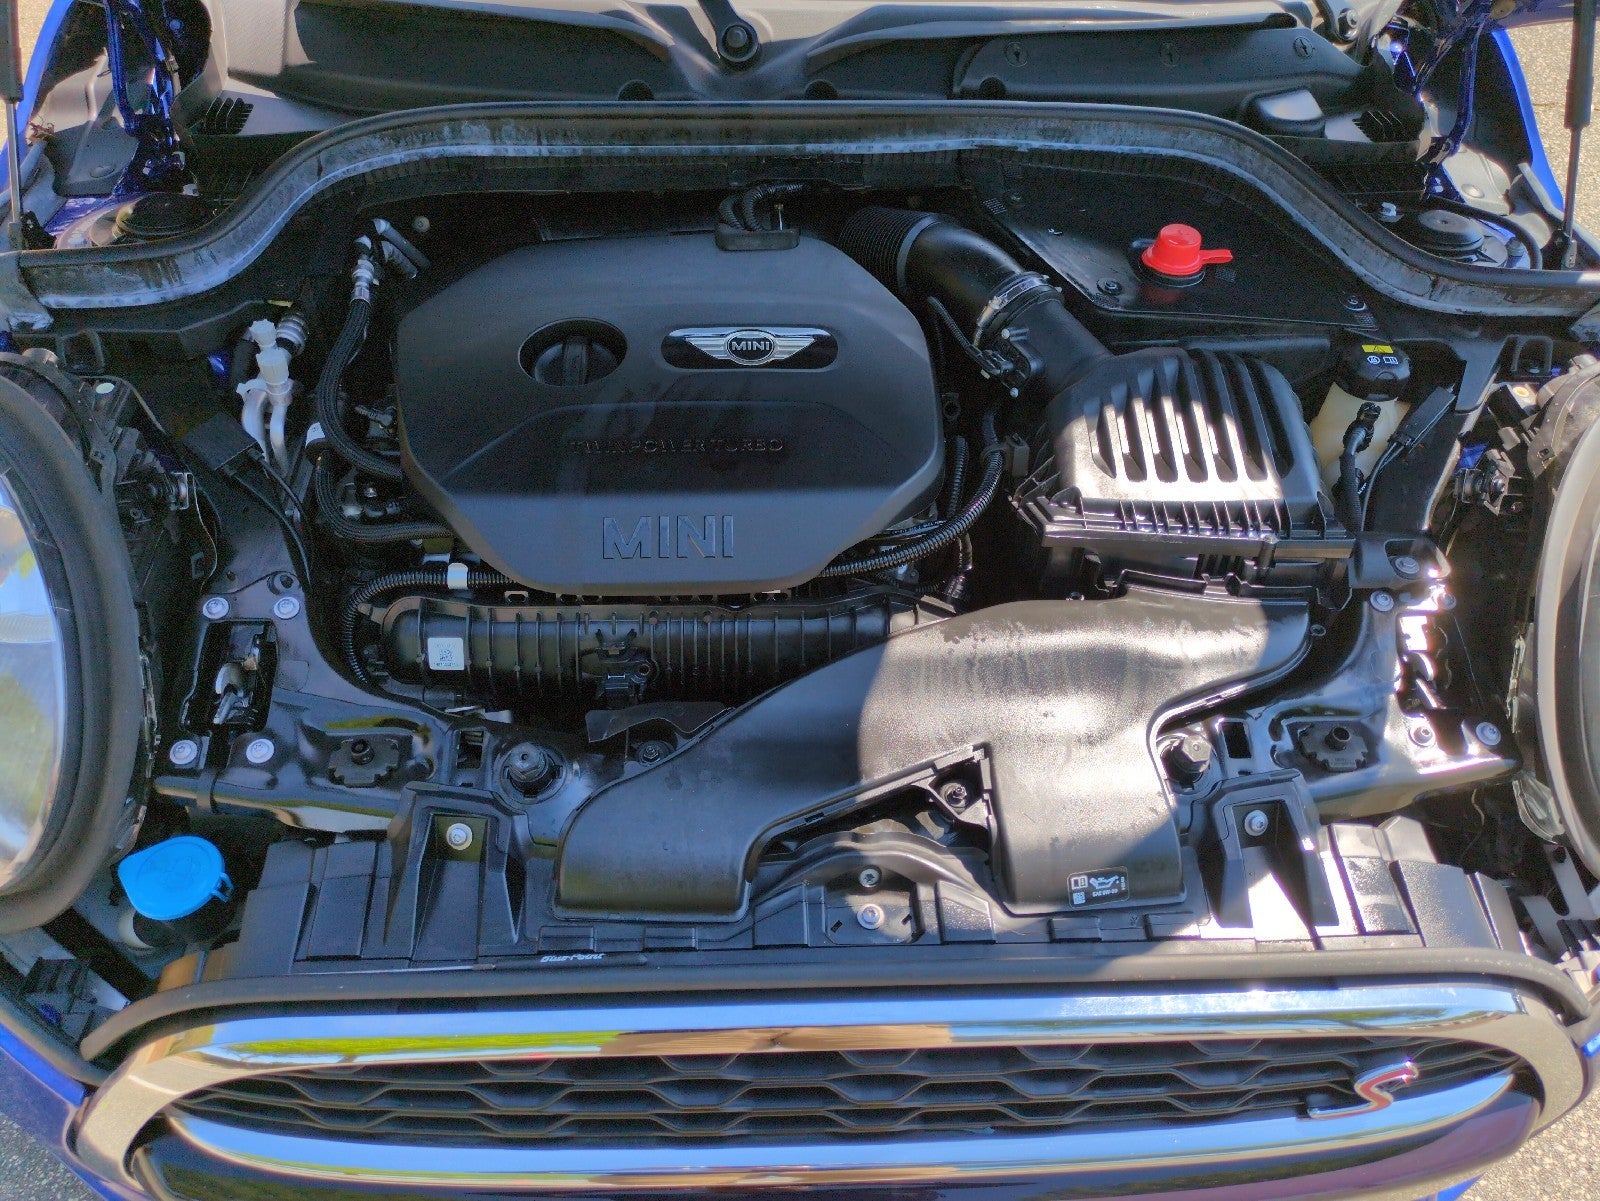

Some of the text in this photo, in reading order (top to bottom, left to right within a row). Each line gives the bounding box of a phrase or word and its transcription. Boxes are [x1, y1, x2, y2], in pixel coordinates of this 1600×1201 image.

[731, 341, 770, 351] MINI
[710, 438, 784, 452] TURBO
[602, 515, 735, 559] MINI
